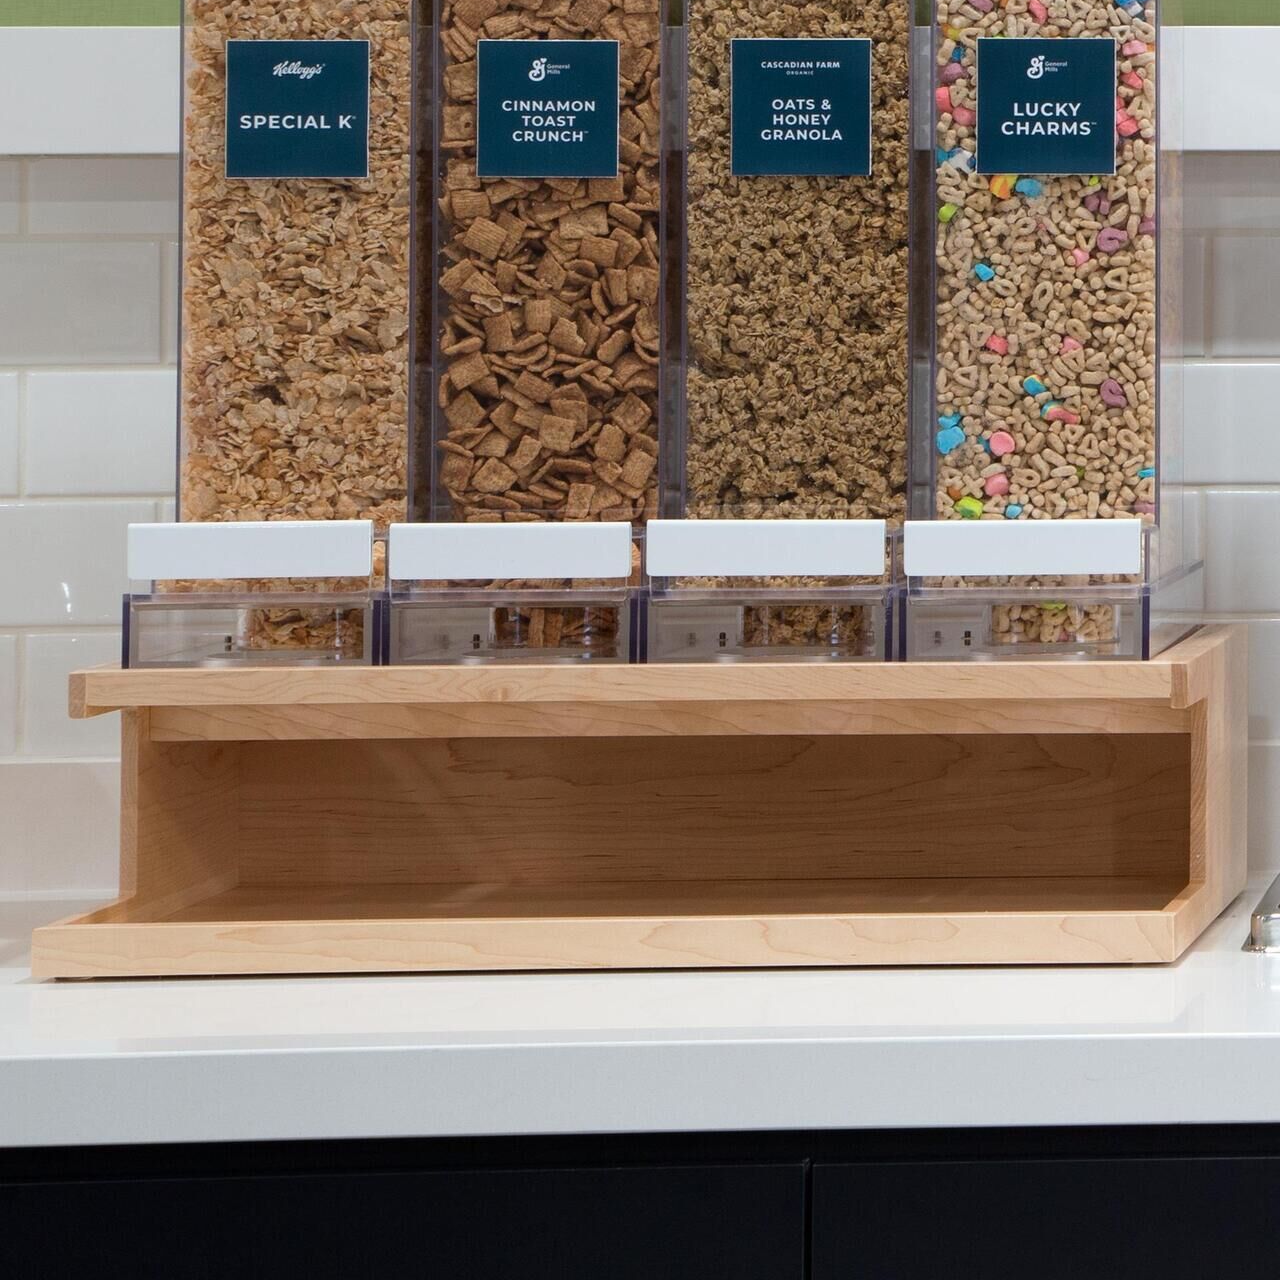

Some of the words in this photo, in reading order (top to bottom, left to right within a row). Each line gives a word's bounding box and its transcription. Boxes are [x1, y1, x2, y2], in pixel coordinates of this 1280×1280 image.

[272, 60, 325, 80] Kellogg's
[760, 61, 813, 69] CASCADIAN
[815, 61, 841, 69] FARM
[501, 100, 596, 112] CINNAMON
[771, 98, 816, 111] OATS
[820, 98, 832, 111] &
[1013, 102, 1081, 117] LUCKY
[239, 114, 331, 130] SPECIAL
[521, 115, 577, 127] TOAST
[772, 113, 831, 126] HONEY
[760, 129, 843, 141] GRANOLA
[1001, 121, 1091, 136] CHARMS
[512, 130, 584, 142] CRUNCH
